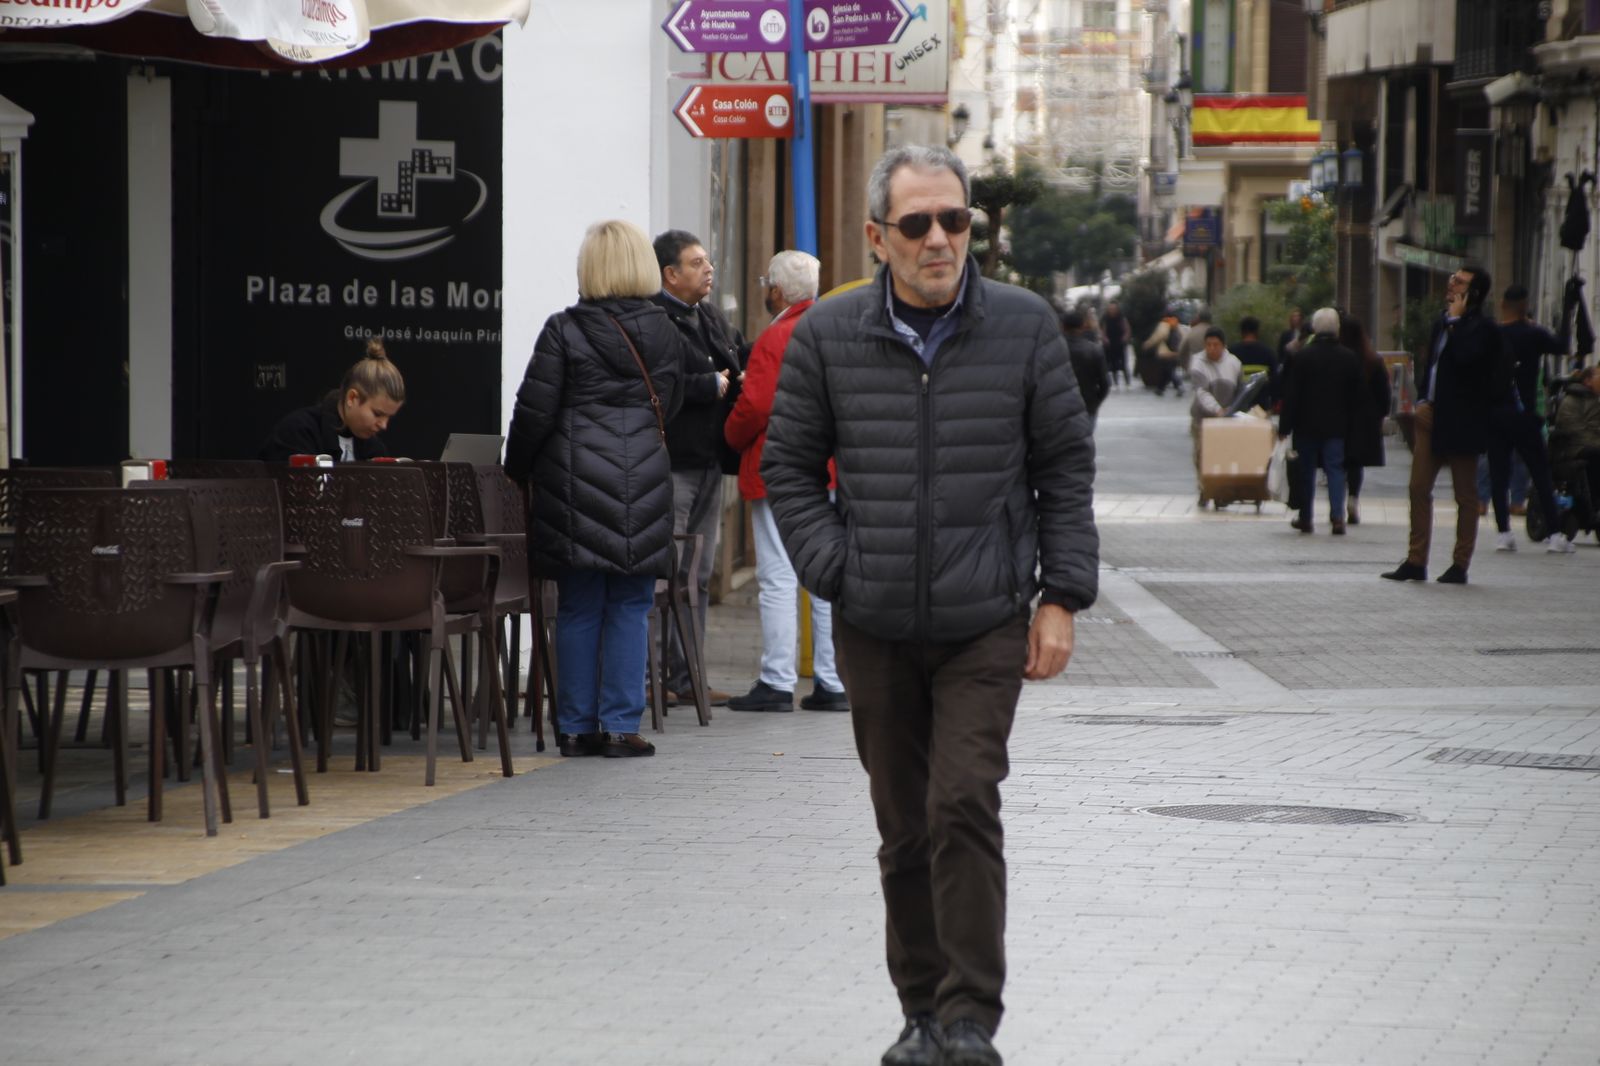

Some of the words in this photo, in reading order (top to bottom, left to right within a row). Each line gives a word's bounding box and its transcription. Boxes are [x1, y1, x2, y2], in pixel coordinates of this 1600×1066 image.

[700, 9, 750, 19] Ayuntamiento
[832, 3, 852, 15] Iglesia
[852, 2, 861, 11] de
[701, 20, 710, 29] de
[711, 20, 736, 29] Huelva
[832, 15, 845, 24] San
[844, 13, 863, 23] Pedro
[894, 33, 941, 71] UNISEX
[712, 99, 733, 109] Casa
[734, 98, 758, 109] Colón
[713, 115, 728, 123] Casa
[729, 113, 746, 123] Colón
[1465, 149, 1481, 216] TIGER
[246, 275, 331, 304] Plaza
[343, 278, 378, 304] de
[390, 280, 435, 306] las
[377, 326, 411, 340] José
[415, 327, 472, 343] Joaquín
